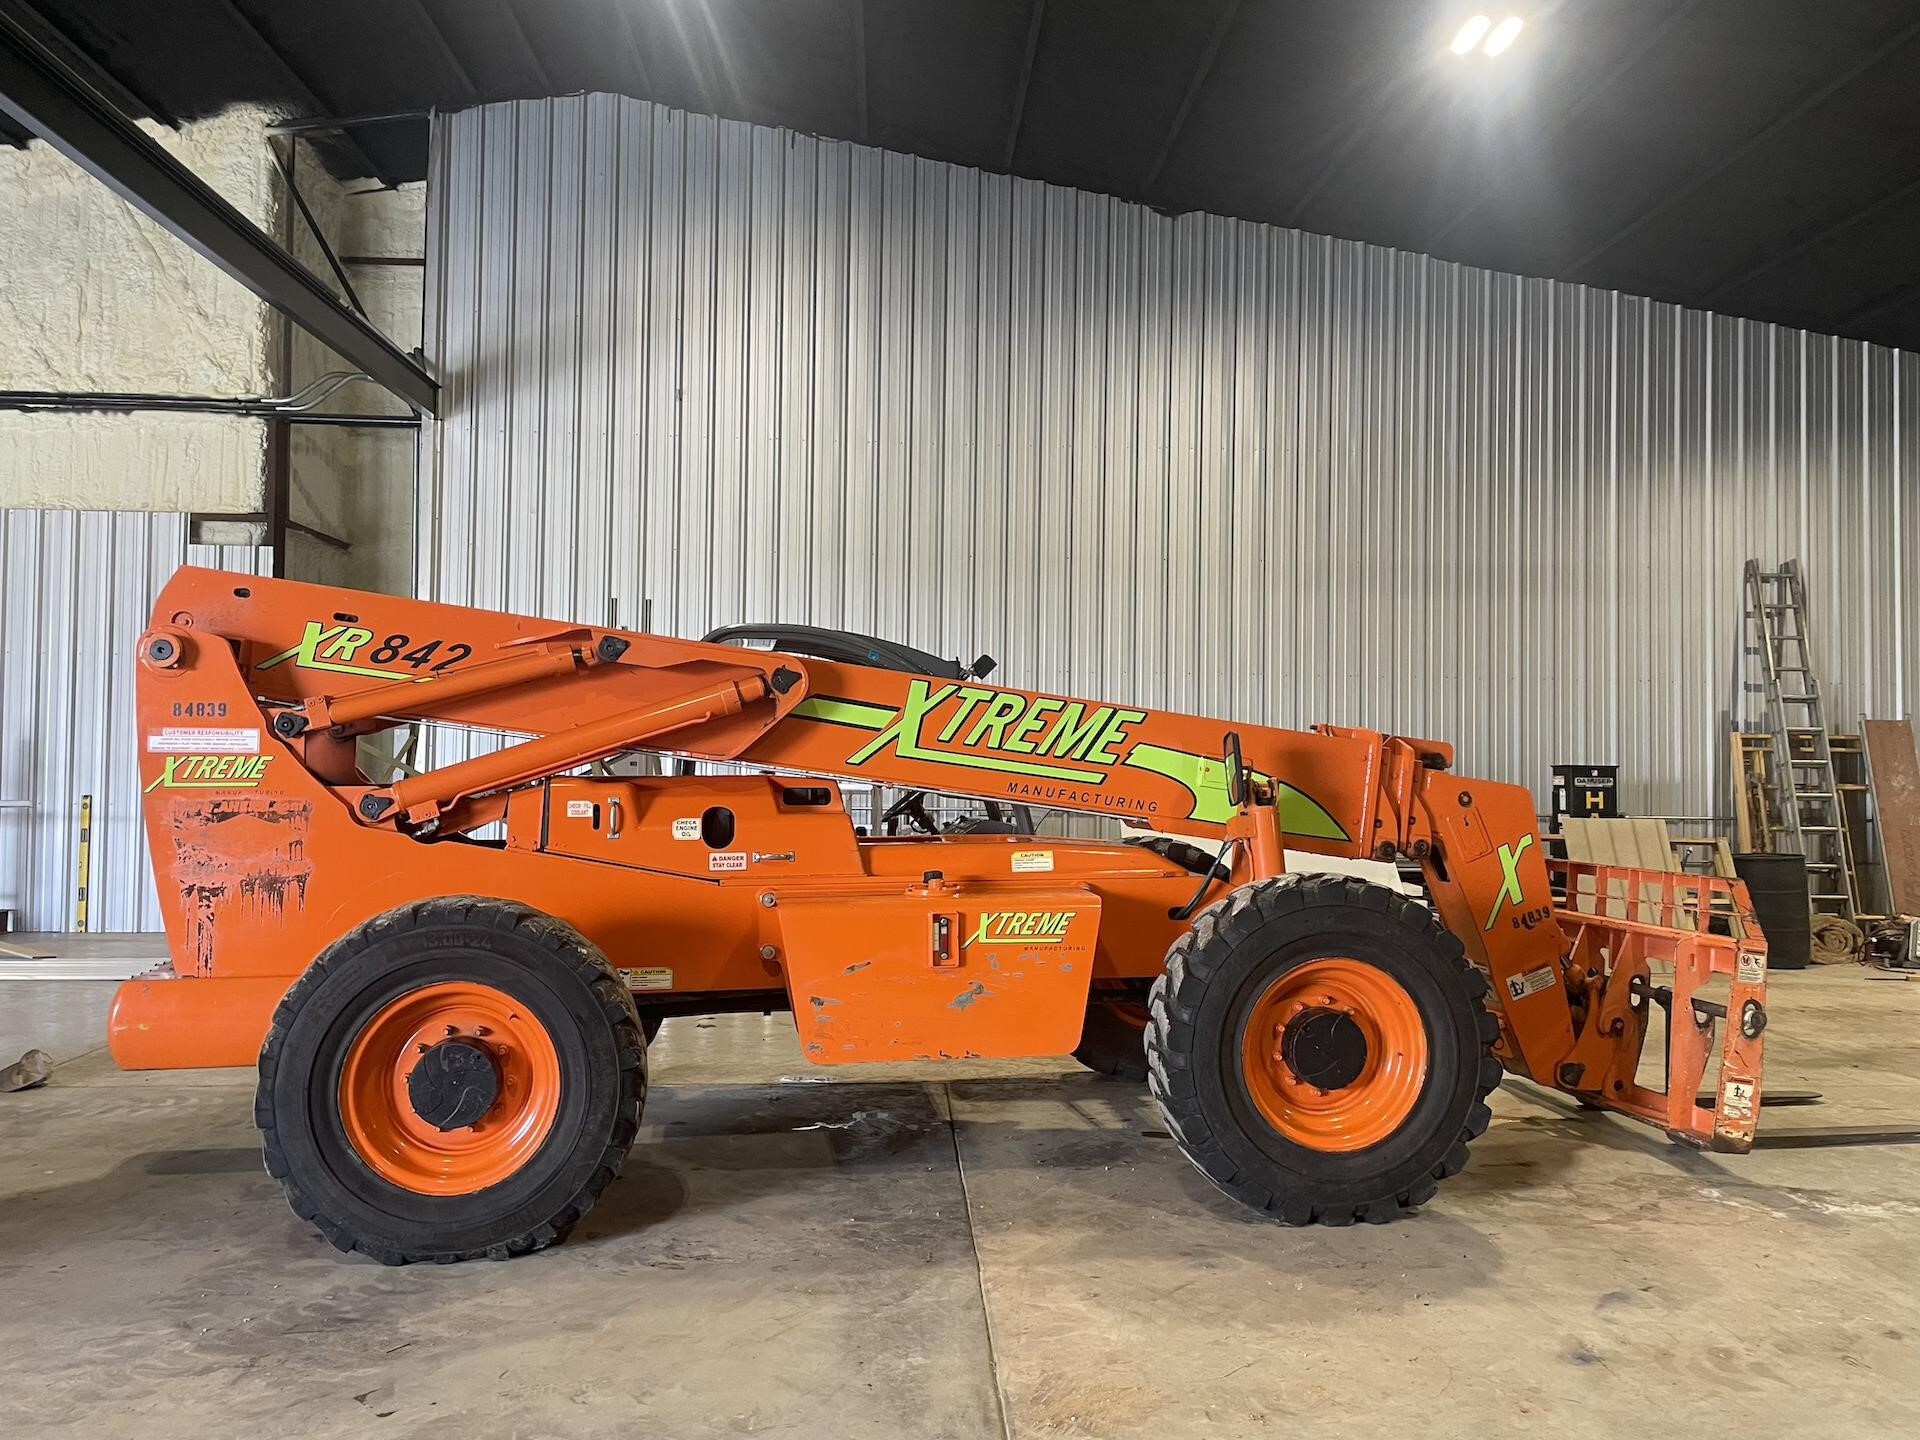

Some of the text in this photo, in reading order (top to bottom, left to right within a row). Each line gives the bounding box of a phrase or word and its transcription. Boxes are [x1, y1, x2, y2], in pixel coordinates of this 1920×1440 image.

[255, 621, 473, 672] XR 842
[172, 702, 228, 718] 84839
[844, 678, 1147, 784] XTREME
[144, 755, 275, 793] XTREME
[1006, 781, 1159, 812] MANUFACTURING
[960, 912, 1077, 950] XTREME
[1511, 906, 1551, 930] 84839
